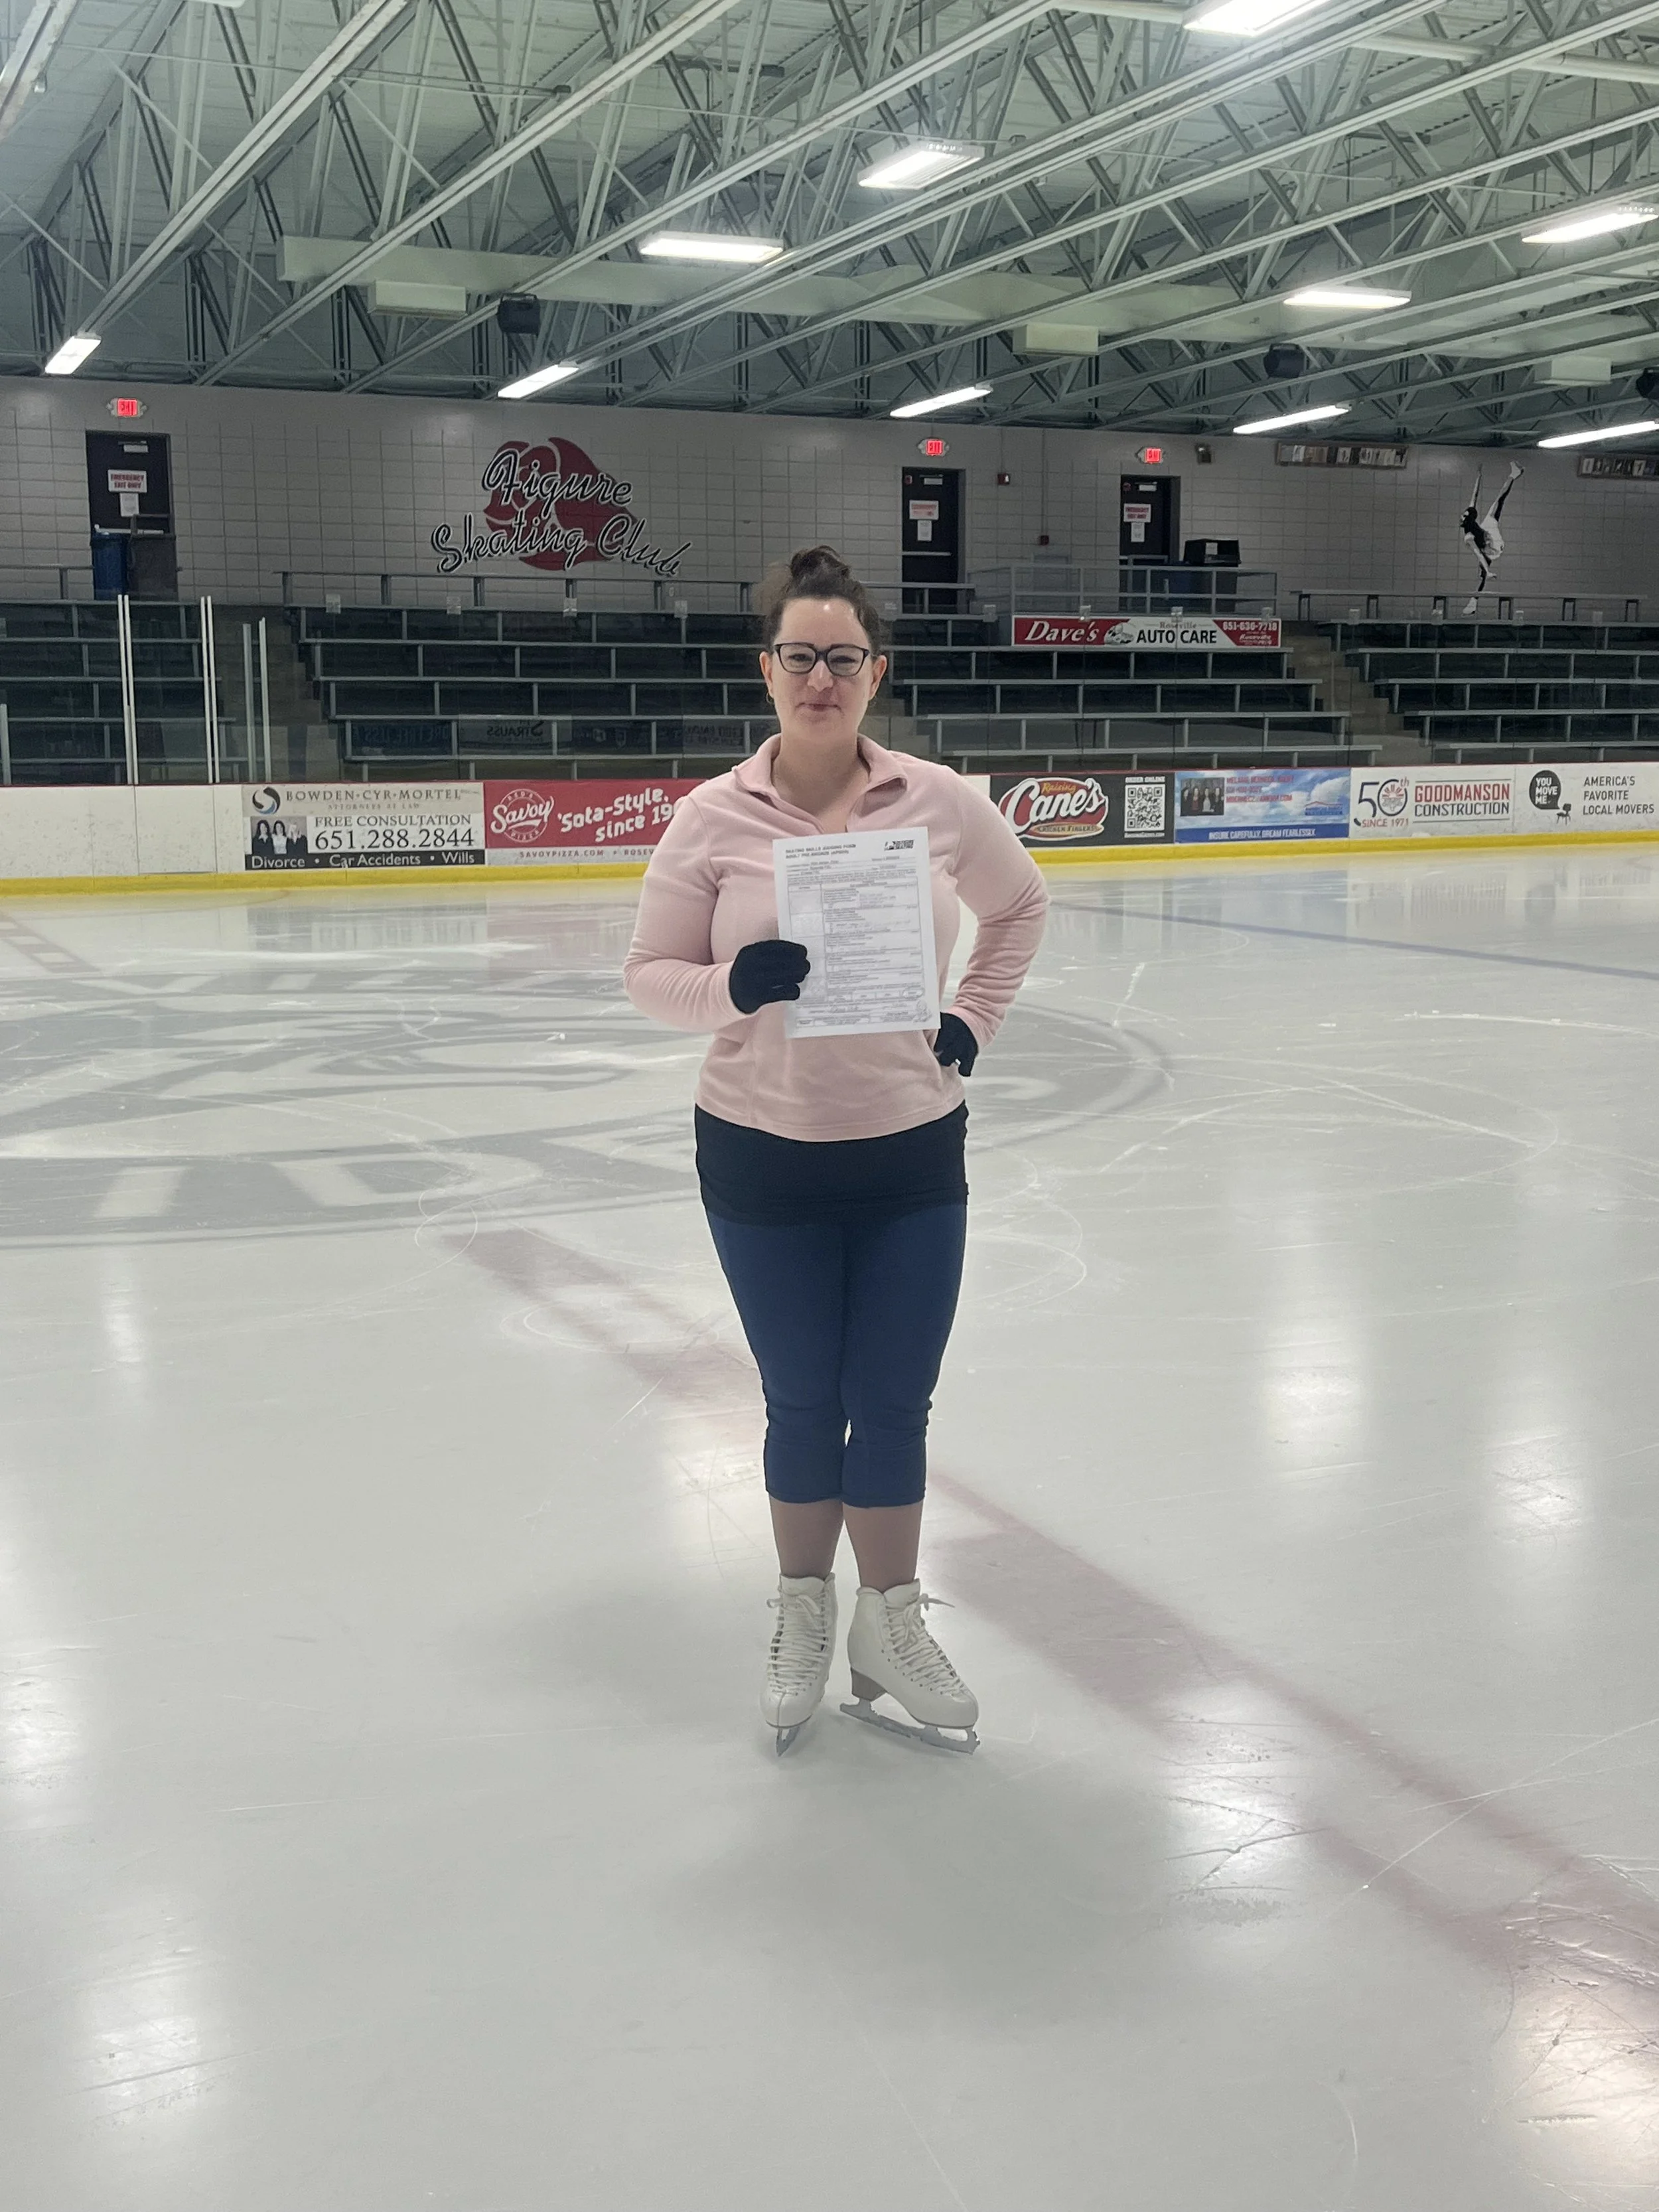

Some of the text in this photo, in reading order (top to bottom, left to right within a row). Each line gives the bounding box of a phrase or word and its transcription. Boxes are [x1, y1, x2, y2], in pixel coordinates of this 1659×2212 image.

[482, 448, 633, 518] Figure
[431, 508, 692, 577] Skating Club
[1025, 621, 1217, 644] Dave's AUTO CARE
[1041, 782, 1077, 794] Raising
[1536, 777, 1552, 786] YOU
[1583, 776, 1635, 786] AMERICA'S
[1414, 783, 1510, 802] GOODMANSON
[1535, 786, 1558, 795] MOVE
[1583, 790, 1629, 800] FAVORITE
[1005, 778, 1105, 834] Cane's
[1414, 802, 1510, 817] CONSTRUCTION
[1583, 804, 1654, 815] LOCAL MOVERS
[315, 814, 471, 828] FREE CONSULTATION
[490, 796, 555, 834] Savoy
[595, 803, 676, 842] since 19
[1362, 818, 1409, 828] SINCE 1971
[315, 828, 474, 850] 651.288.2844
[510, 830, 540, 841] PIZZA
[252, 851, 474, 869] Divorce Car Accidents Wills
[520, 849, 605, 858] SAVOYPIZZA.COM
